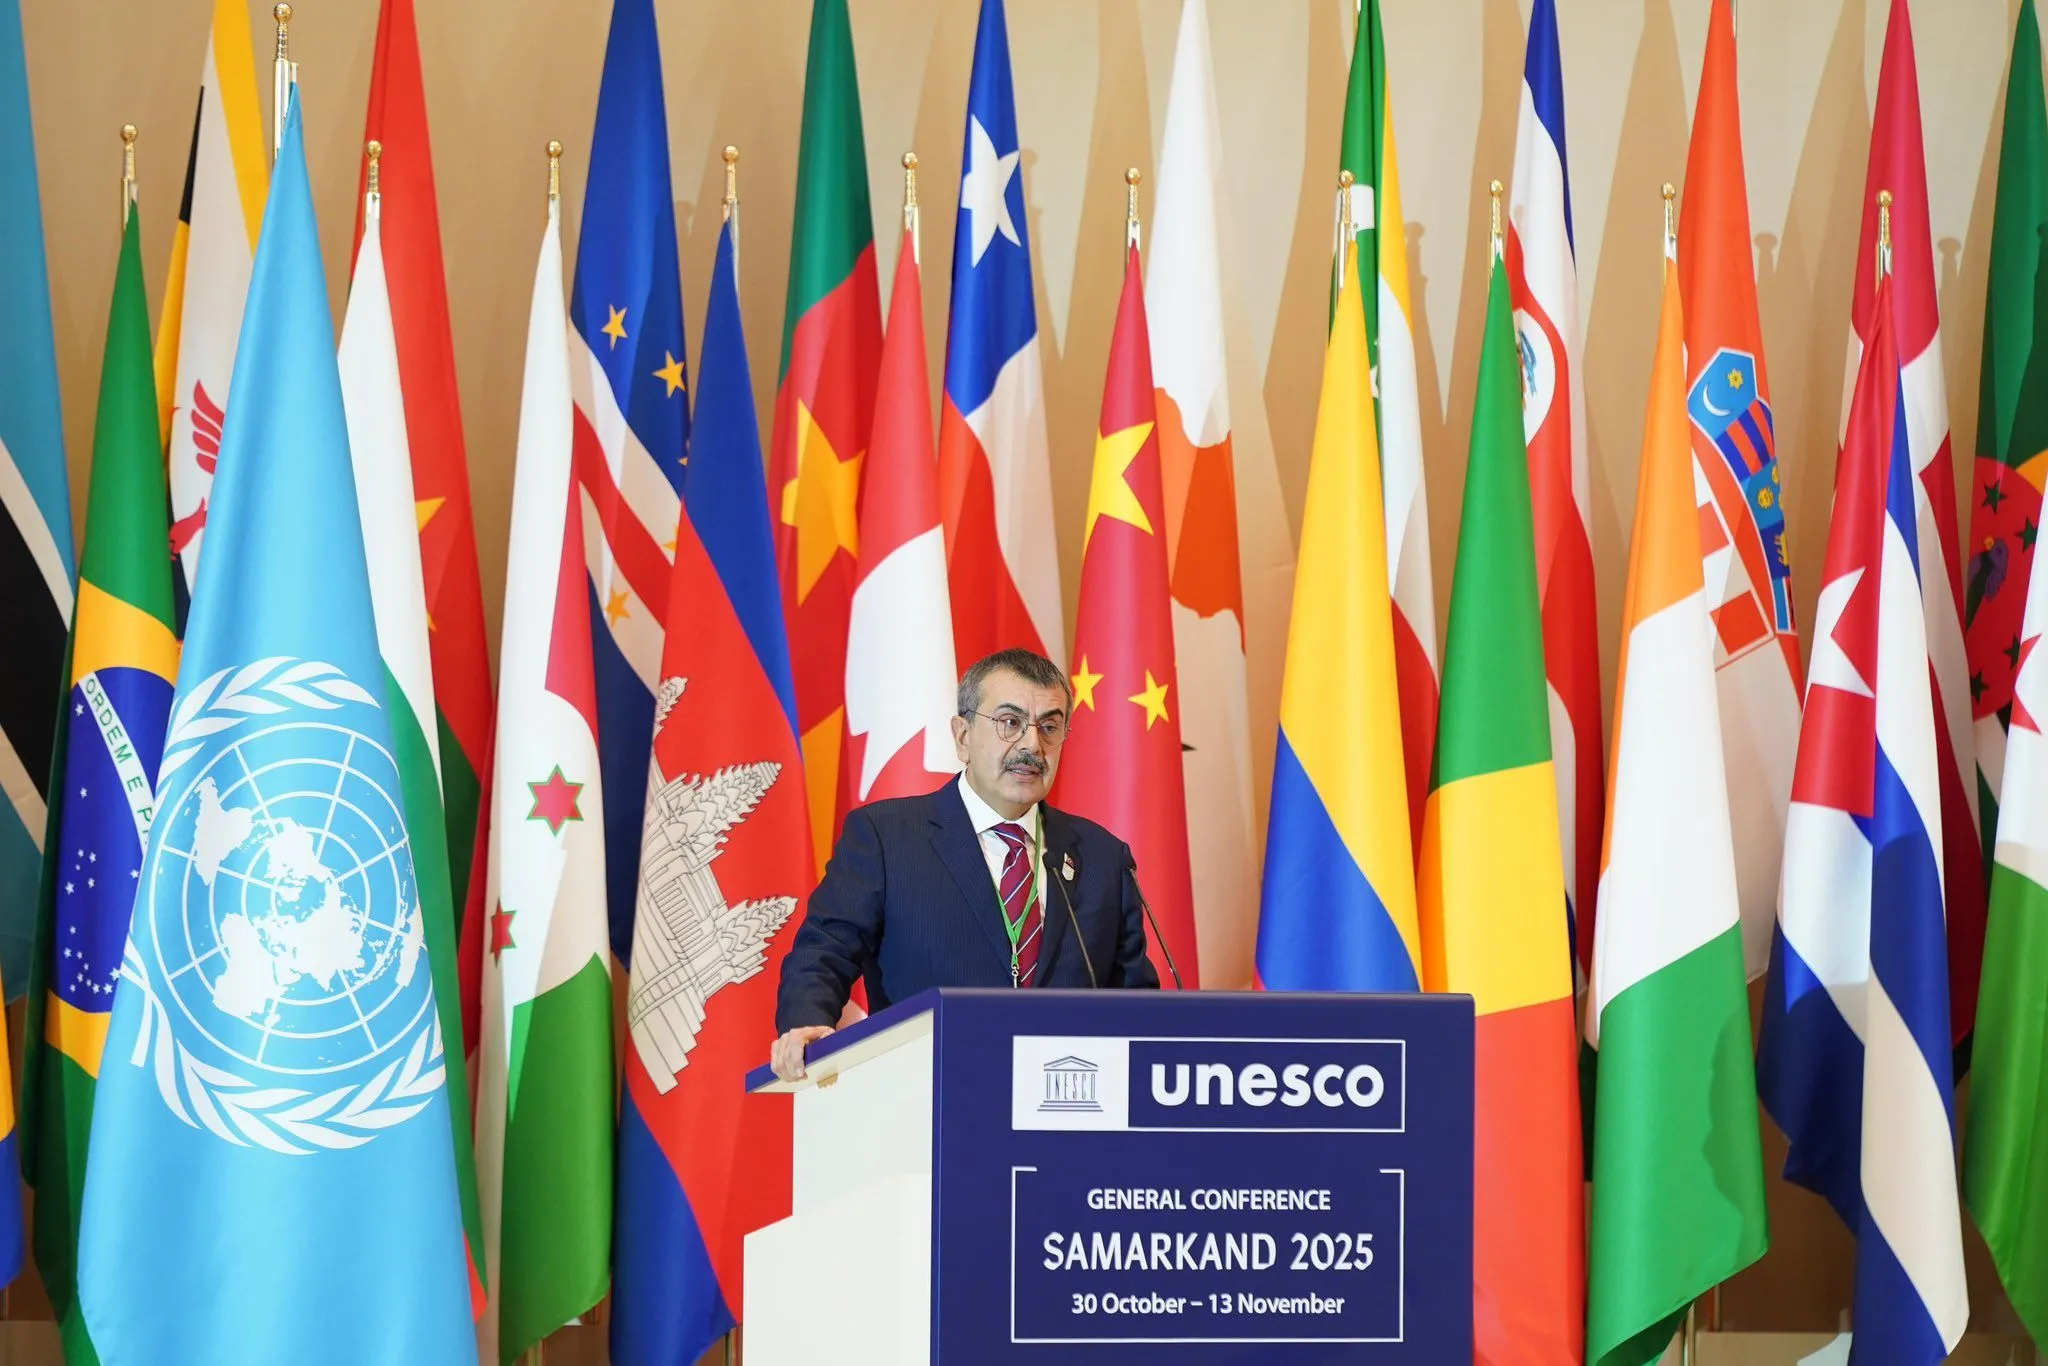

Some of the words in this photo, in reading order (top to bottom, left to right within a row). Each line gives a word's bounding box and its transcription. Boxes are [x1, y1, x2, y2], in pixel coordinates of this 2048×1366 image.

[85, 678, 133, 764] ORDEM
[126, 775, 144, 793] E
[1045, 1072, 1096, 1101] UNESCO
[1150, 1063, 1385, 1108] unesco
[1087, 1188, 1187, 1211] GENERAL
[1190, 1188, 1331, 1211] CONFERENCE
[1043, 1231, 1277, 1271] SAMARKAND
[1289, 1232, 1374, 1271] 2025
[1071, 1293, 1098, 1315] 30
[1101, 1291, 1187, 1315] October
[1208, 1292, 1233, 1314] 13
[1237, 1291, 1346, 1315] November
